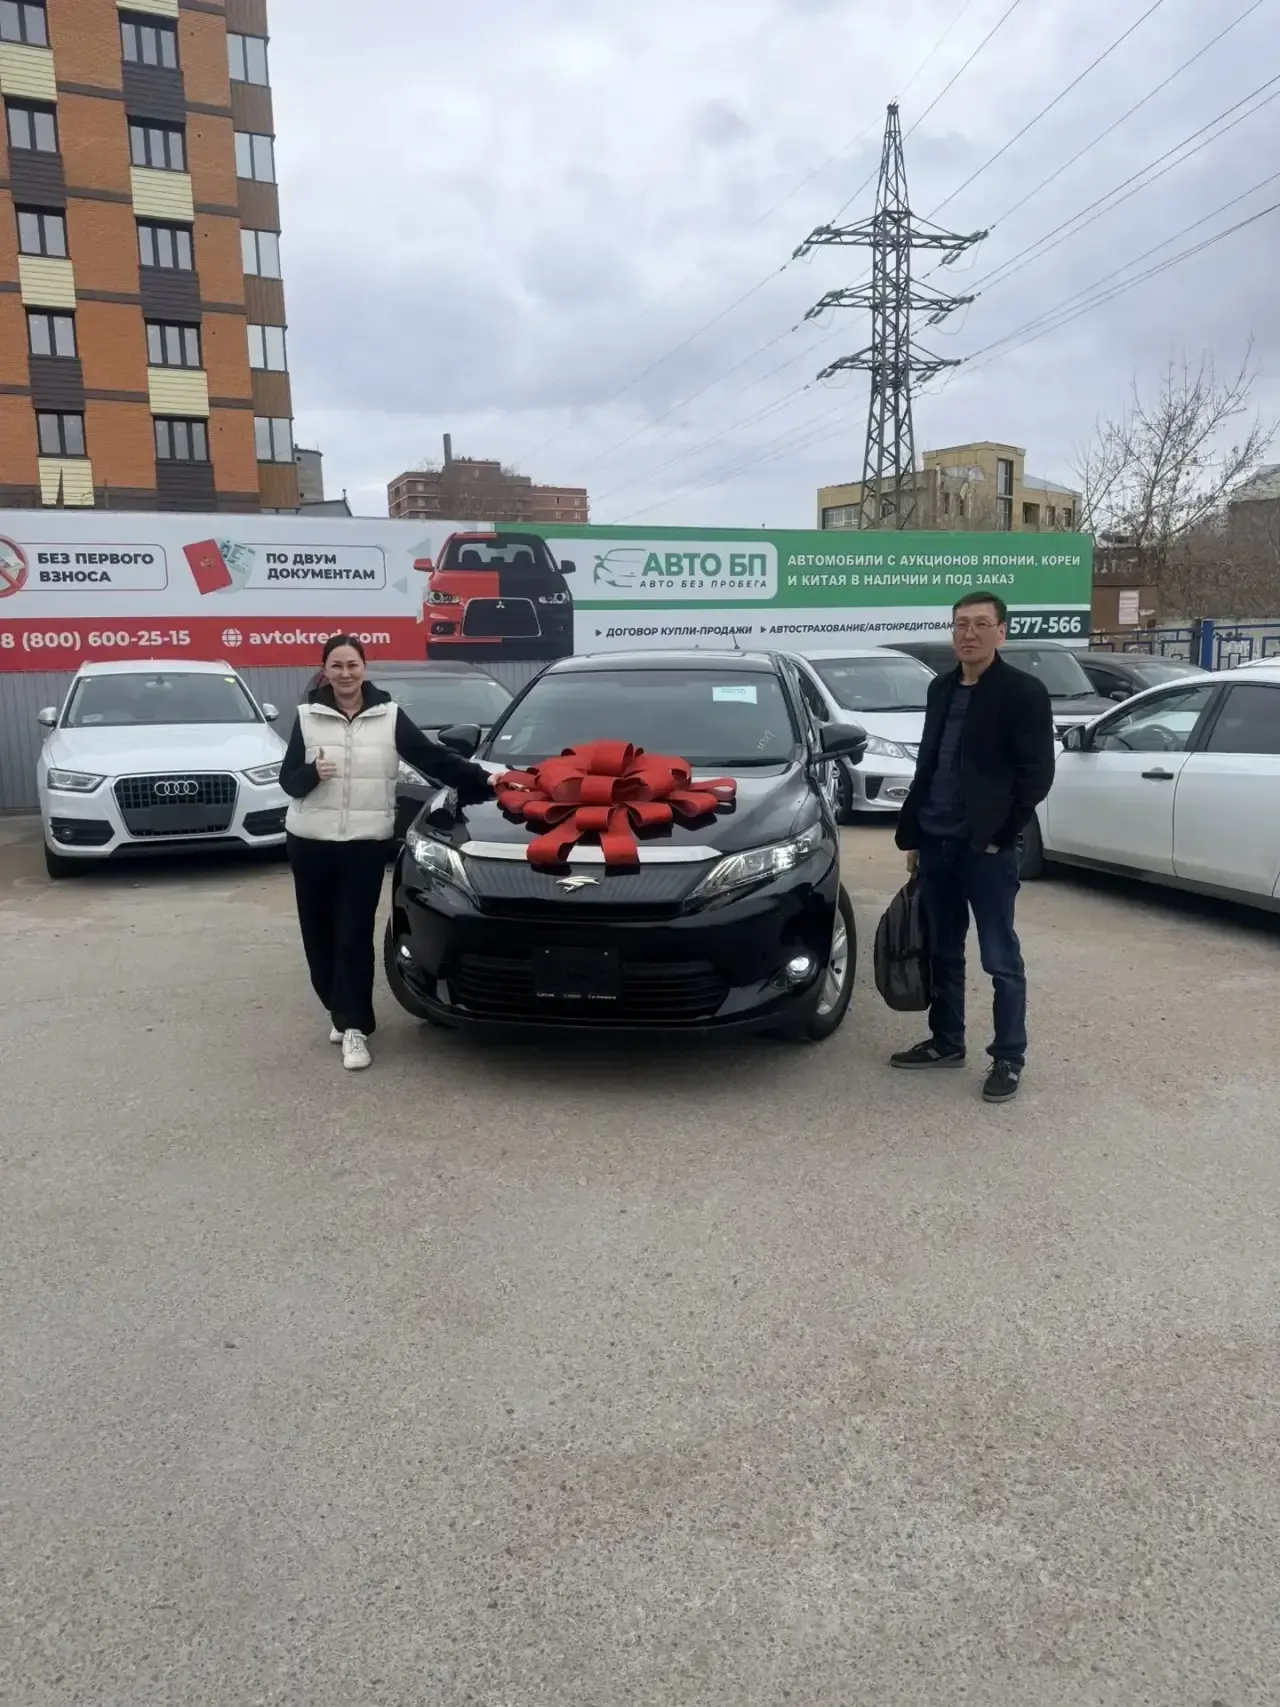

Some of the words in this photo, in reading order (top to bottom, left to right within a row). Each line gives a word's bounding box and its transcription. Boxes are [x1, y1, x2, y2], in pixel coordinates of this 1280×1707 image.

[37, 552, 70, 565] БЕЗ
[74, 552, 154, 565] ПЕРВОГО
[266, 552, 289, 565] ПО
[292, 553, 337, 566] ДВУМ
[642, 552, 722, 577] АВТО
[729, 552, 767, 577] БП
[787, 554, 883, 567] АВТОМОБИЛИ
[887, 554, 896, 566] С
[899, 554, 978, 568] АУКЦИОНОВ
[982, 554, 1038, 568] ЯПОНИИ,
[1041, 555, 1081, 566] КОРЕИ
[39, 570, 112, 583] ВЗНОСА
[267, 567, 375, 581] ДОКУМЕНТАМ
[787, 575, 797, 586] И
[801, 574, 847, 586] КИТАЯ
[851, 574, 860, 586] В
[863, 574, 928, 586] НАЛИЧИИ
[932, 574, 941, 585] И
[945, 574, 973, 587] ПОД
[975, 573, 1015, 585] ЗАКАЗ
[639, 579, 674, 588] АВТО
[681, 579, 704, 588] БЕЗ
[710, 579, 767, 589] ПРОБЕГА
[605, 627, 659, 638] ДОГОВОР
[660, 625, 752, 637] КУПЛИ-ПРОДАЖИ
[769, 620, 953, 635] АВТОСТРАХОВАНИЕ/АВТОКРЕДИТОВАН
[1009, 616, 1082, 634] 577-566
[0, 632, 15, 649] 8
[22, 630, 81, 652] (800)
[88, 630, 191, 647] 600-25-15
[249, 628, 391, 646] avtokrecom
